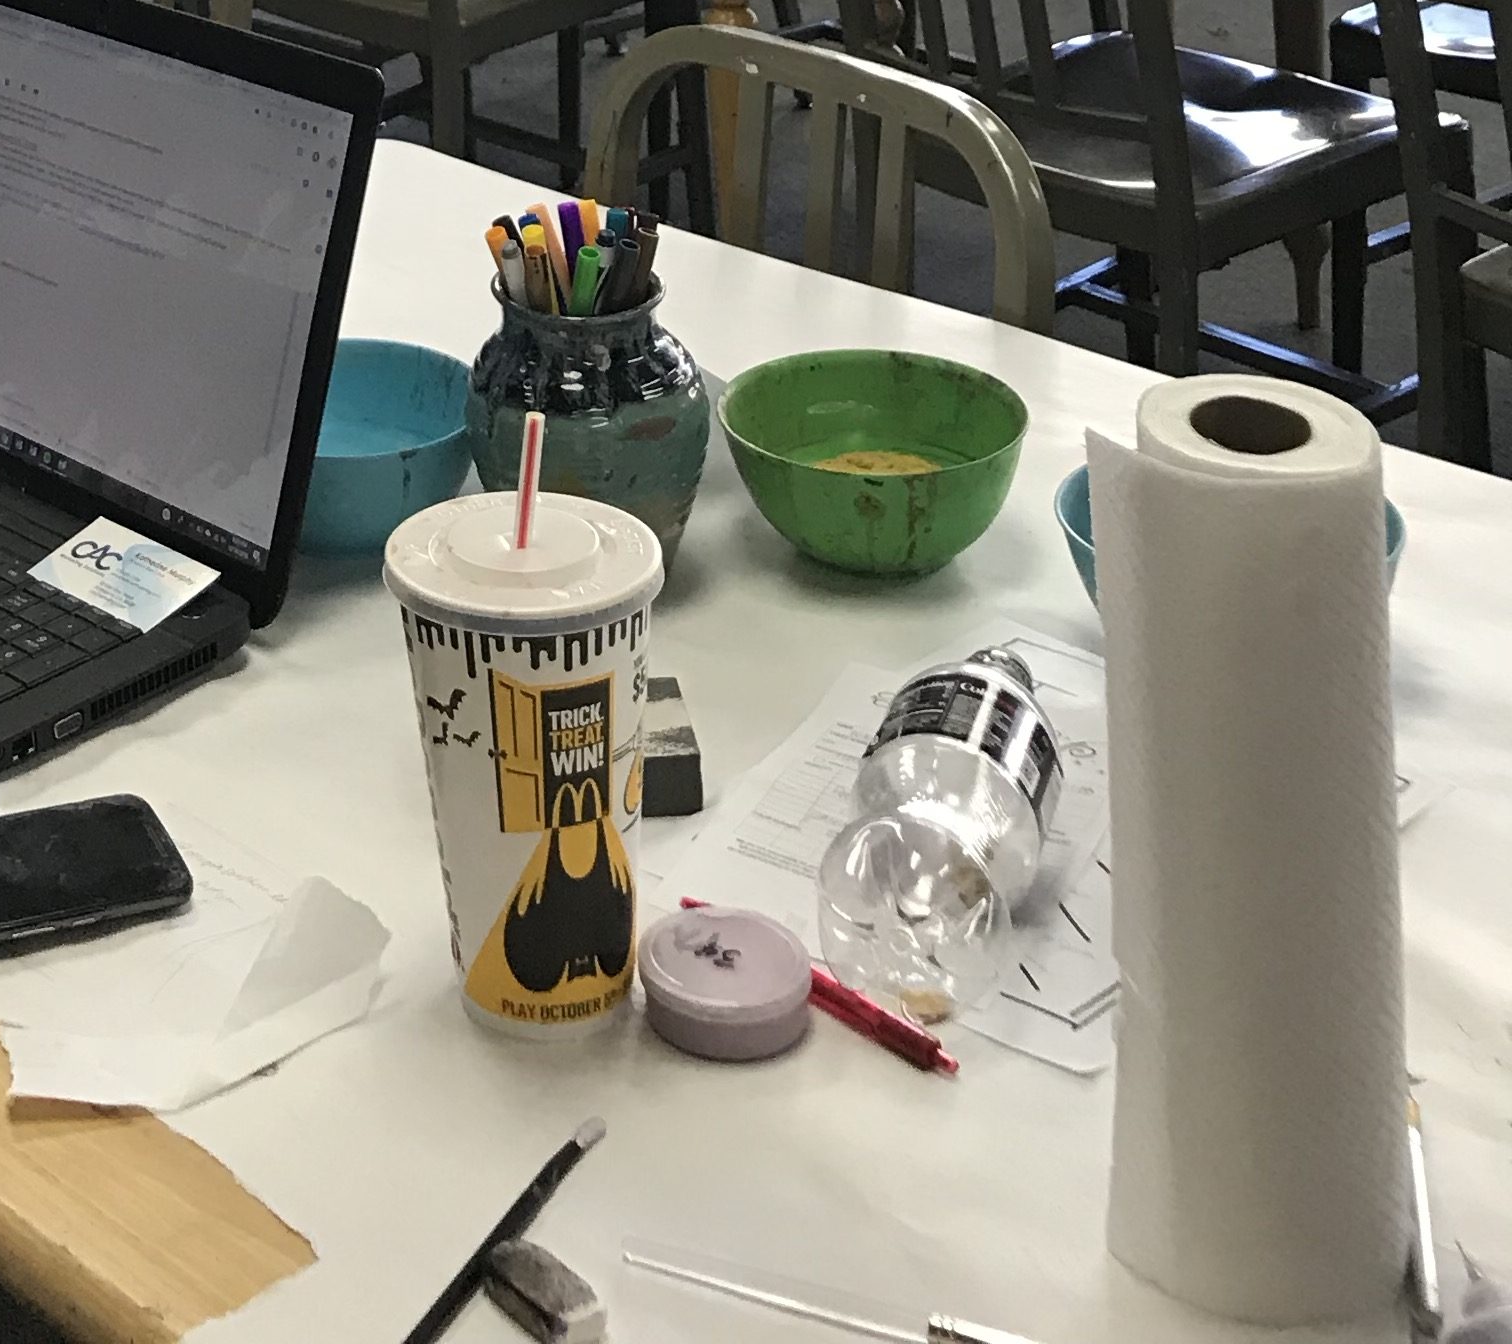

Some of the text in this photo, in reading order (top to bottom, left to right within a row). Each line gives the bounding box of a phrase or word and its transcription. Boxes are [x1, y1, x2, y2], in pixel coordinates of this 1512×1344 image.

[550, 742, 605, 777] WIN!
[500, 996, 602, 1022] PLAY OCTOBER
